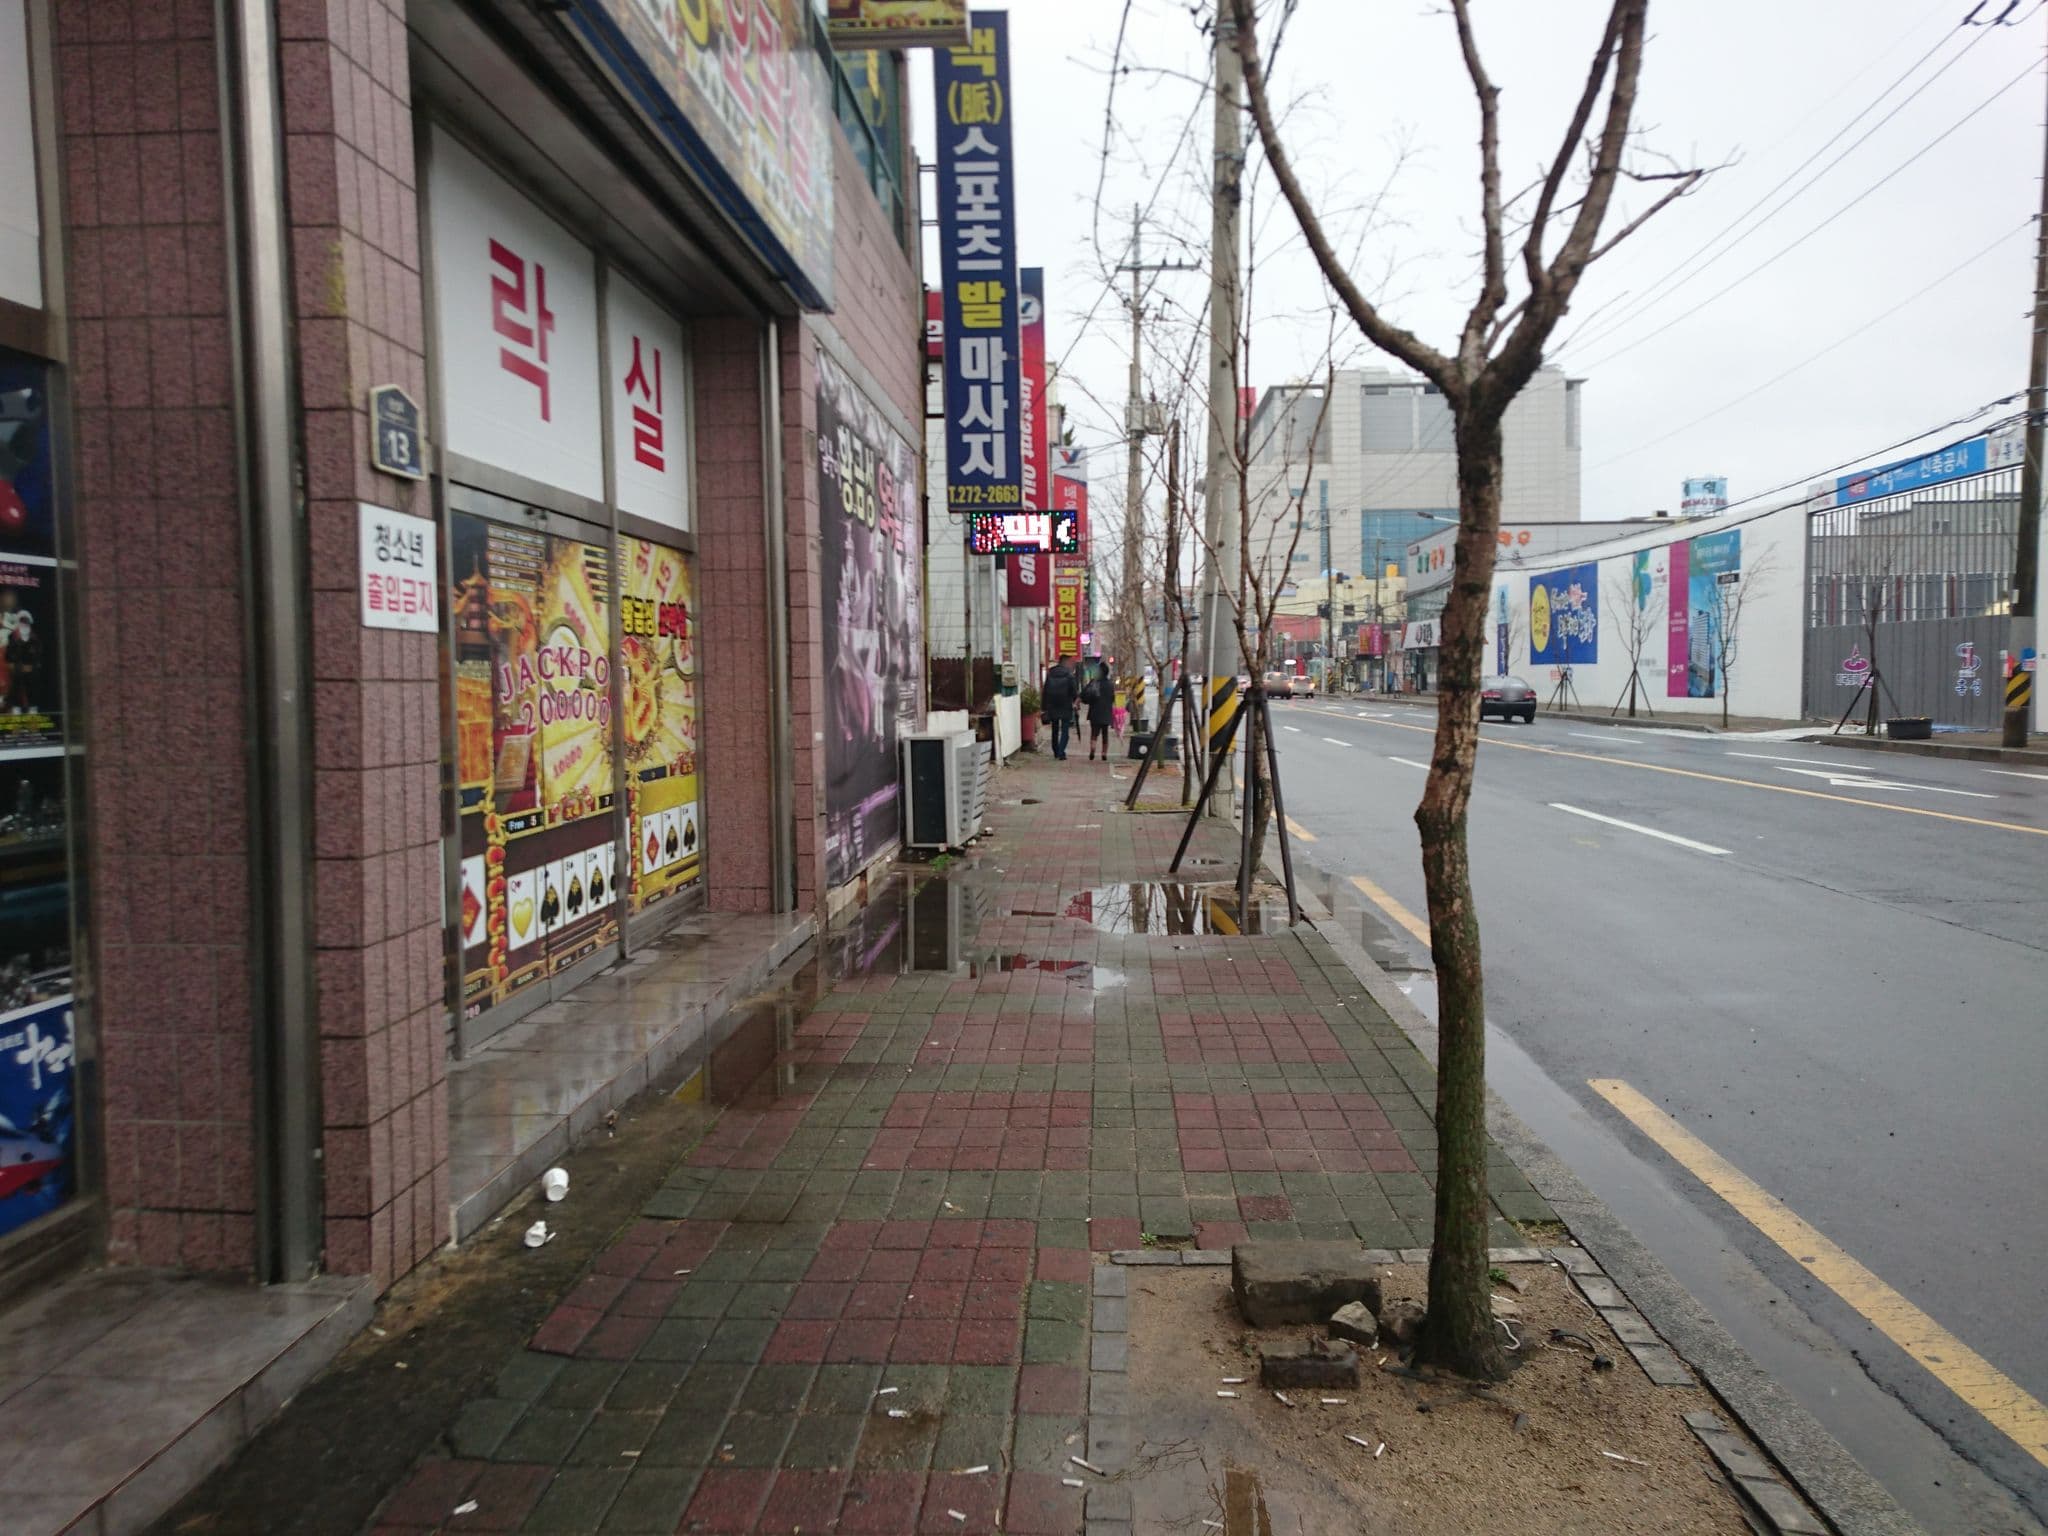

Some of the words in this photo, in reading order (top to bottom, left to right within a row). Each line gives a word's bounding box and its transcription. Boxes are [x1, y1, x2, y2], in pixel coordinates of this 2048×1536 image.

[953, 127, 1003, 271] 스포츠
[958, 336, 1009, 479] 마사지
[388, 429, 411, 465] 13
[1920, 448, 1969, 479] 신축공사
[949, 485, 1019, 504] T.272-2663
[375, 524, 424, 568] 청소년
[367, 574, 433, 616] 출입금지
[502, 647, 610, 701] JACKPO
